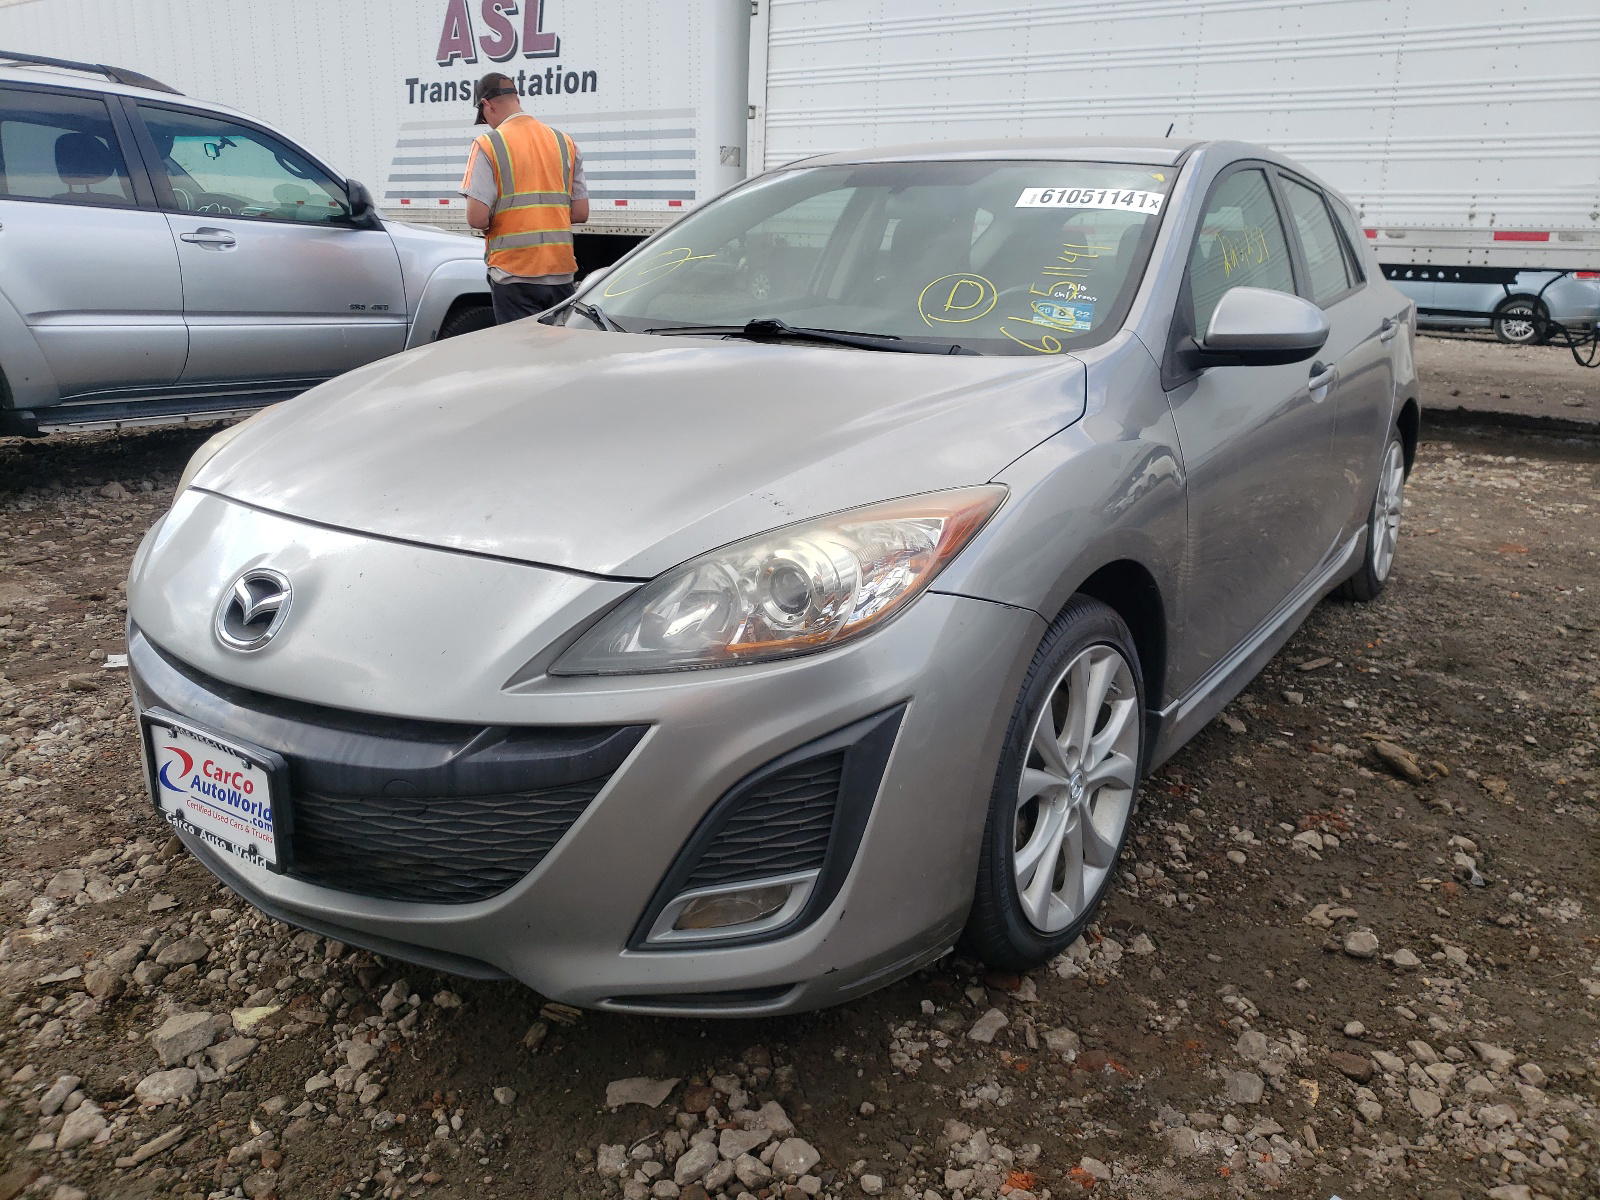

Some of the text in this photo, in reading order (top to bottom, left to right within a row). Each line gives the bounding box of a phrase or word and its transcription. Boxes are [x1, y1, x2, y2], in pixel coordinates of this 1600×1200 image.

[436, 0, 561, 67] ASL
[405, 65, 597, 106] Transtation
[1040, 188, 1148, 208] 61051141
[944, 279, 984, 311] D
[202, 760, 254, 795] CarCo
[190, 775, 273, 823] AutoWorld
[186, 799, 212, 817] Certified
[212, 810, 229, 825] Used
[229, 818, 244, 832] Cars
[251, 827, 273, 844] Trucks
